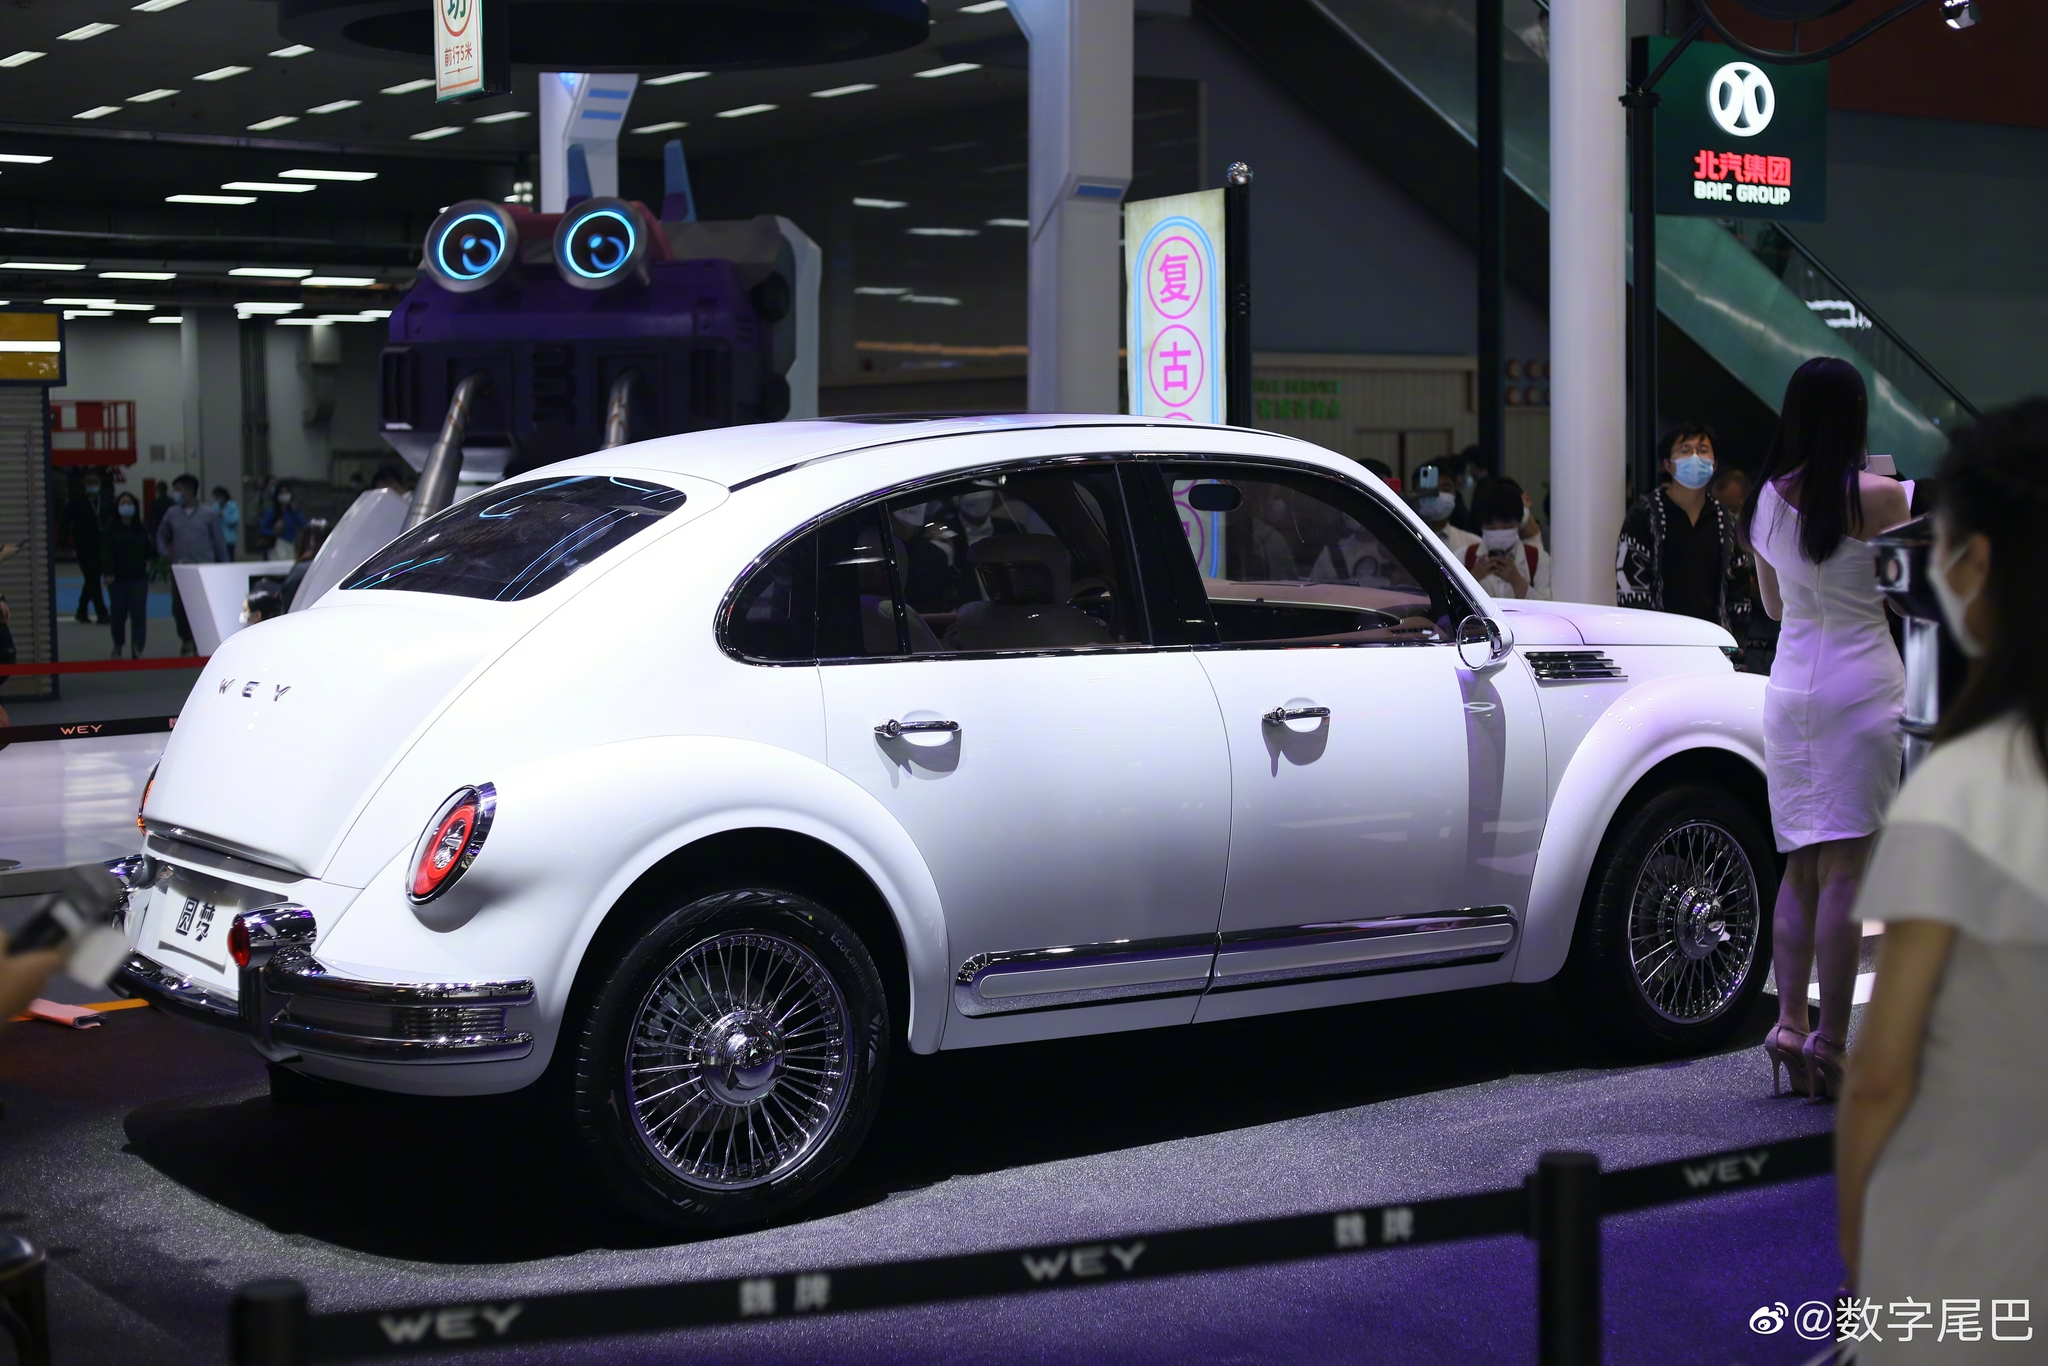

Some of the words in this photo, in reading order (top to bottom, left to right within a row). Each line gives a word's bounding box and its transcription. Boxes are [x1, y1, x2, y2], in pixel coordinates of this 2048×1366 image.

[444, 42, 473, 67] 前行5米
[1694, 150, 1791, 186] 北汽集团
[1694, 180, 1732, 201] BAIC
[1736, 184, 1791, 205] GROUP
[1159, 254, 1192, 391] 复古
[218, 679, 291, 701] WEY
[60, 724, 102, 735] WEY
[830, 931, 872, 992] EcoContact
[1681, 1150, 1770, 1189] WEY
[1020, 1240, 1148, 1282] WEY
[378, 1302, 524, 1345] WEY
